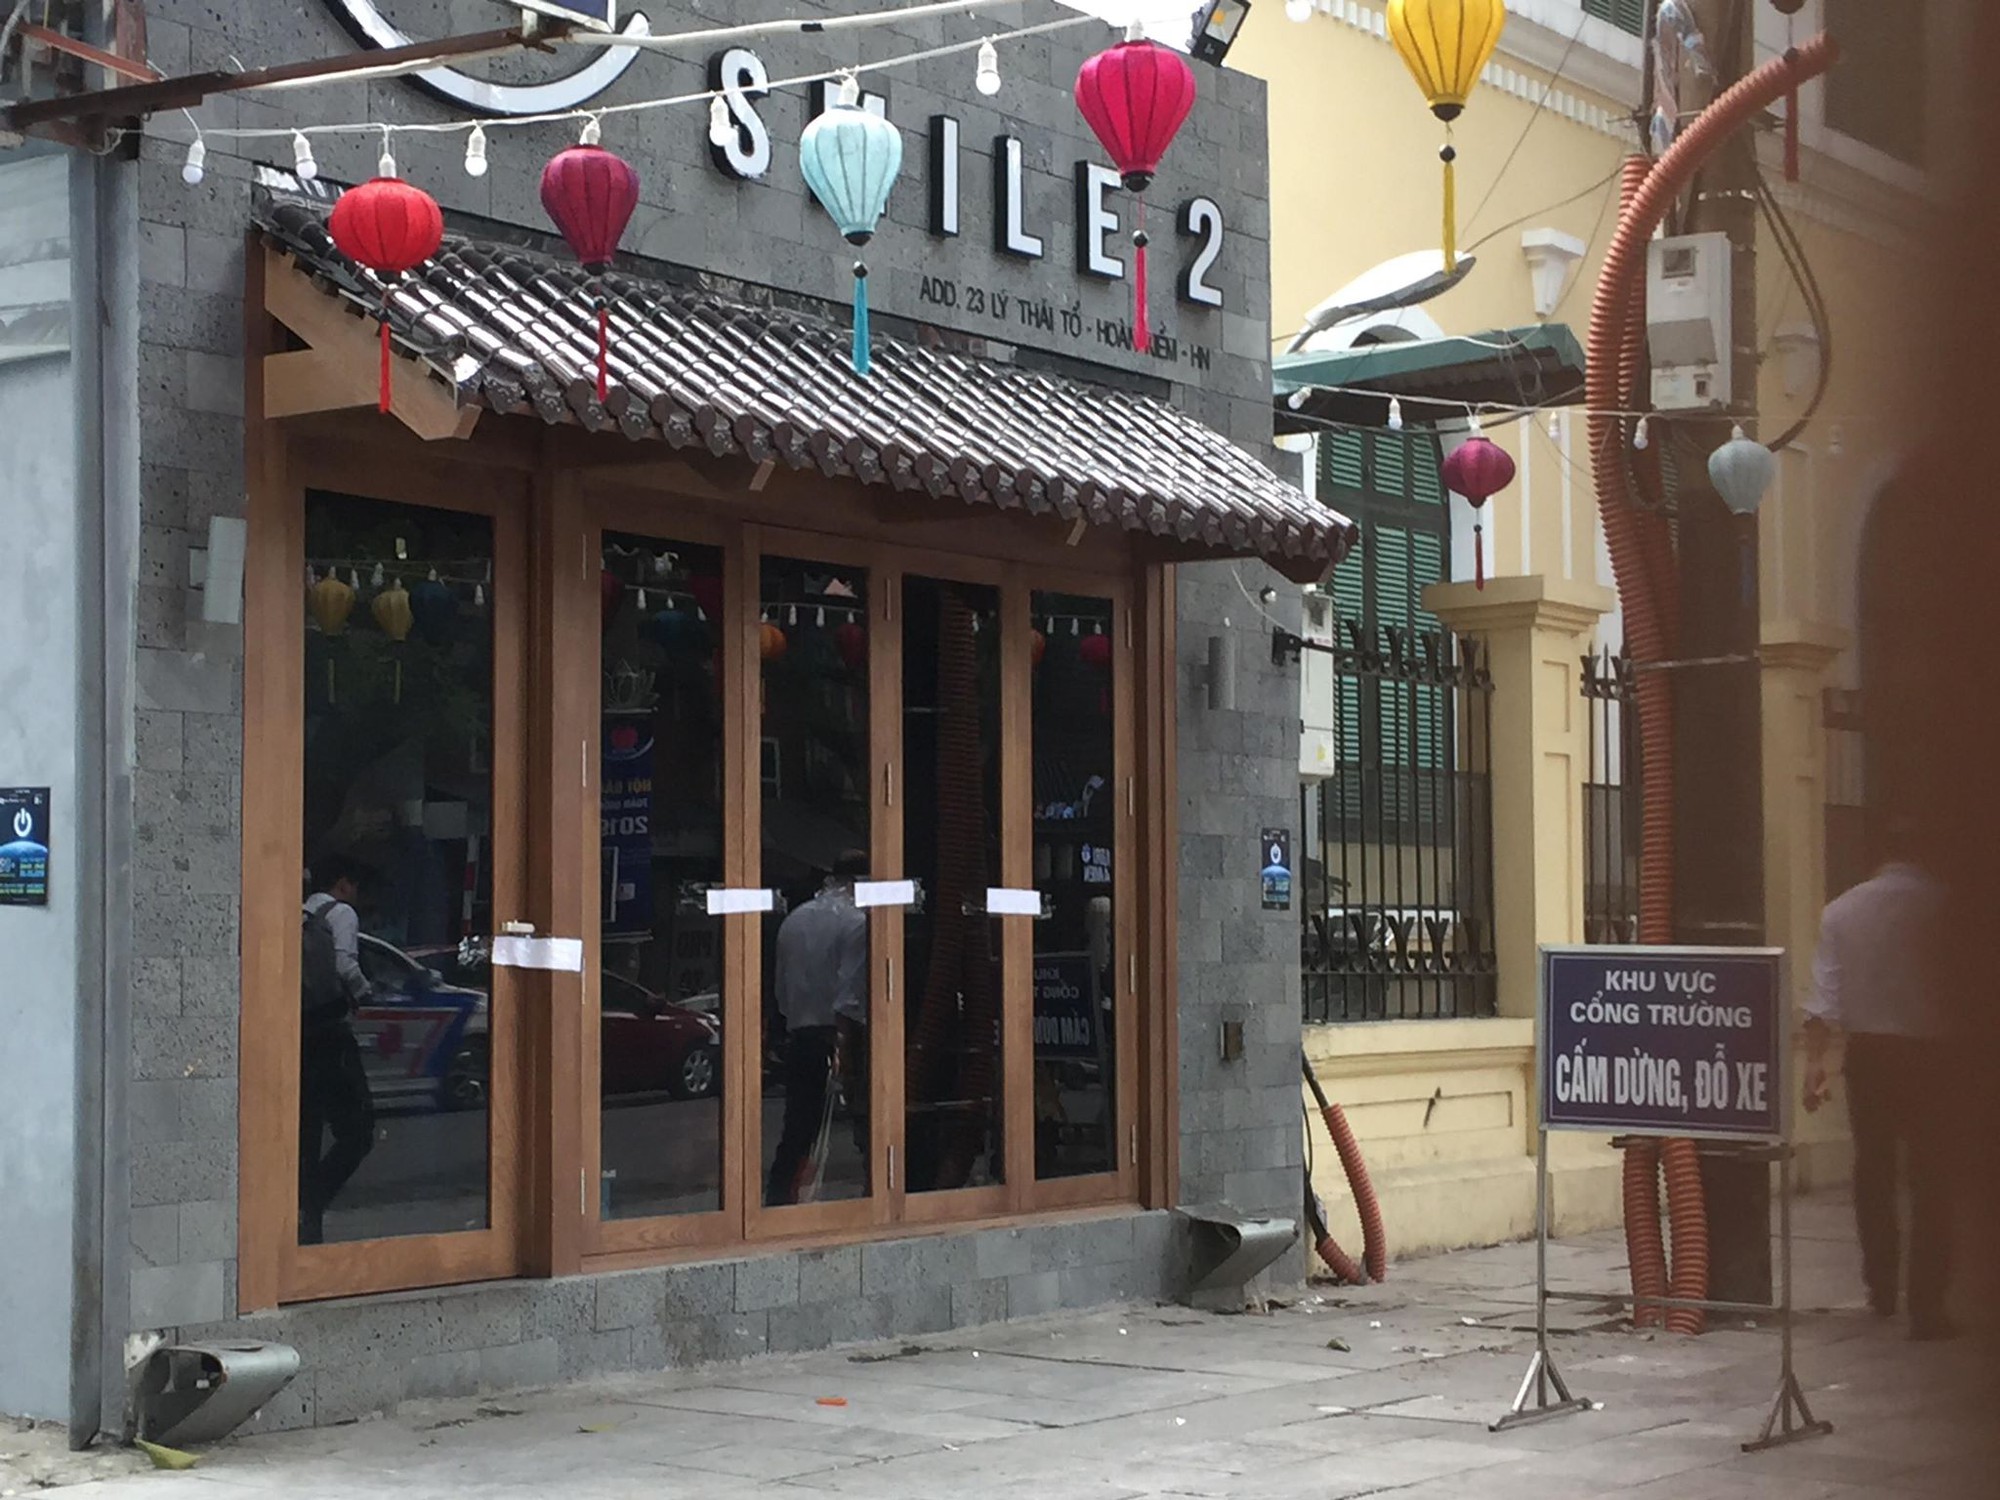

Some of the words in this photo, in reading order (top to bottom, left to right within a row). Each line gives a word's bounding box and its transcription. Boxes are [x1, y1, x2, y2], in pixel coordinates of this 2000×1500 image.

[708, 46, 1125, 280] SILE
[1178, 196, 1224, 307] 2
[919, 275, 961, 309] ADD.
[966, 286, 985, 314] 23
[991, 289, 1009, 319] LÝ
[1060, 301, 1082, 338] TỔ
[1190, 344, 1210, 371] HN
[1570, 990, 1640, 1024] CỔNG
[1647, 1000, 1752, 1028] TRƯỜNG
[1605, 970, 1656, 992] KHU
[1663, 969, 1716, 999] VỰC
[1556, 1037, 1608, 1104] CẤM
[1614, 1047, 1688, 1114] DỪNG,
[1695, 1043, 1729, 1109] ĐỖ
[1735, 1062, 1768, 1111] XE
